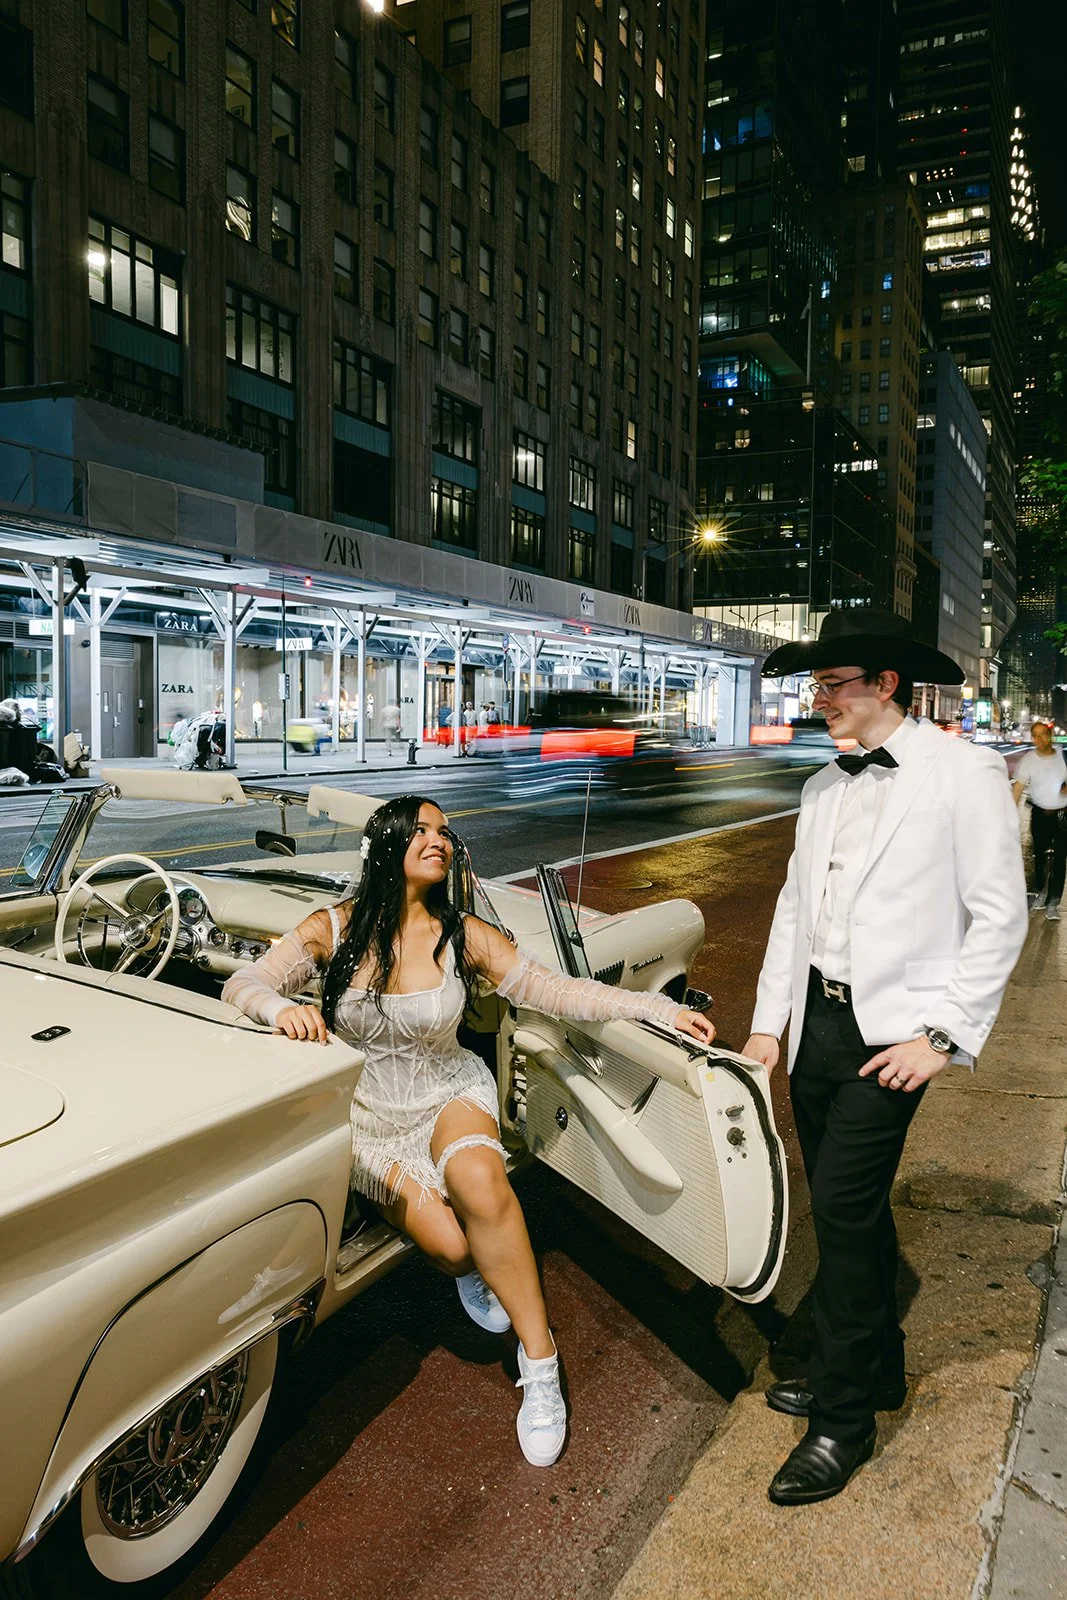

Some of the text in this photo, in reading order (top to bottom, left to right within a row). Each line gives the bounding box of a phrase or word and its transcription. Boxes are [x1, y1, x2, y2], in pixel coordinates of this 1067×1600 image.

[324, 532, 362, 569] ZARA
[509, 577, 533, 604] ZARA
[164, 619, 198, 632] ZARA
[624, 604, 641, 626] ZARA
[161, 683, 194, 694] ZARA
